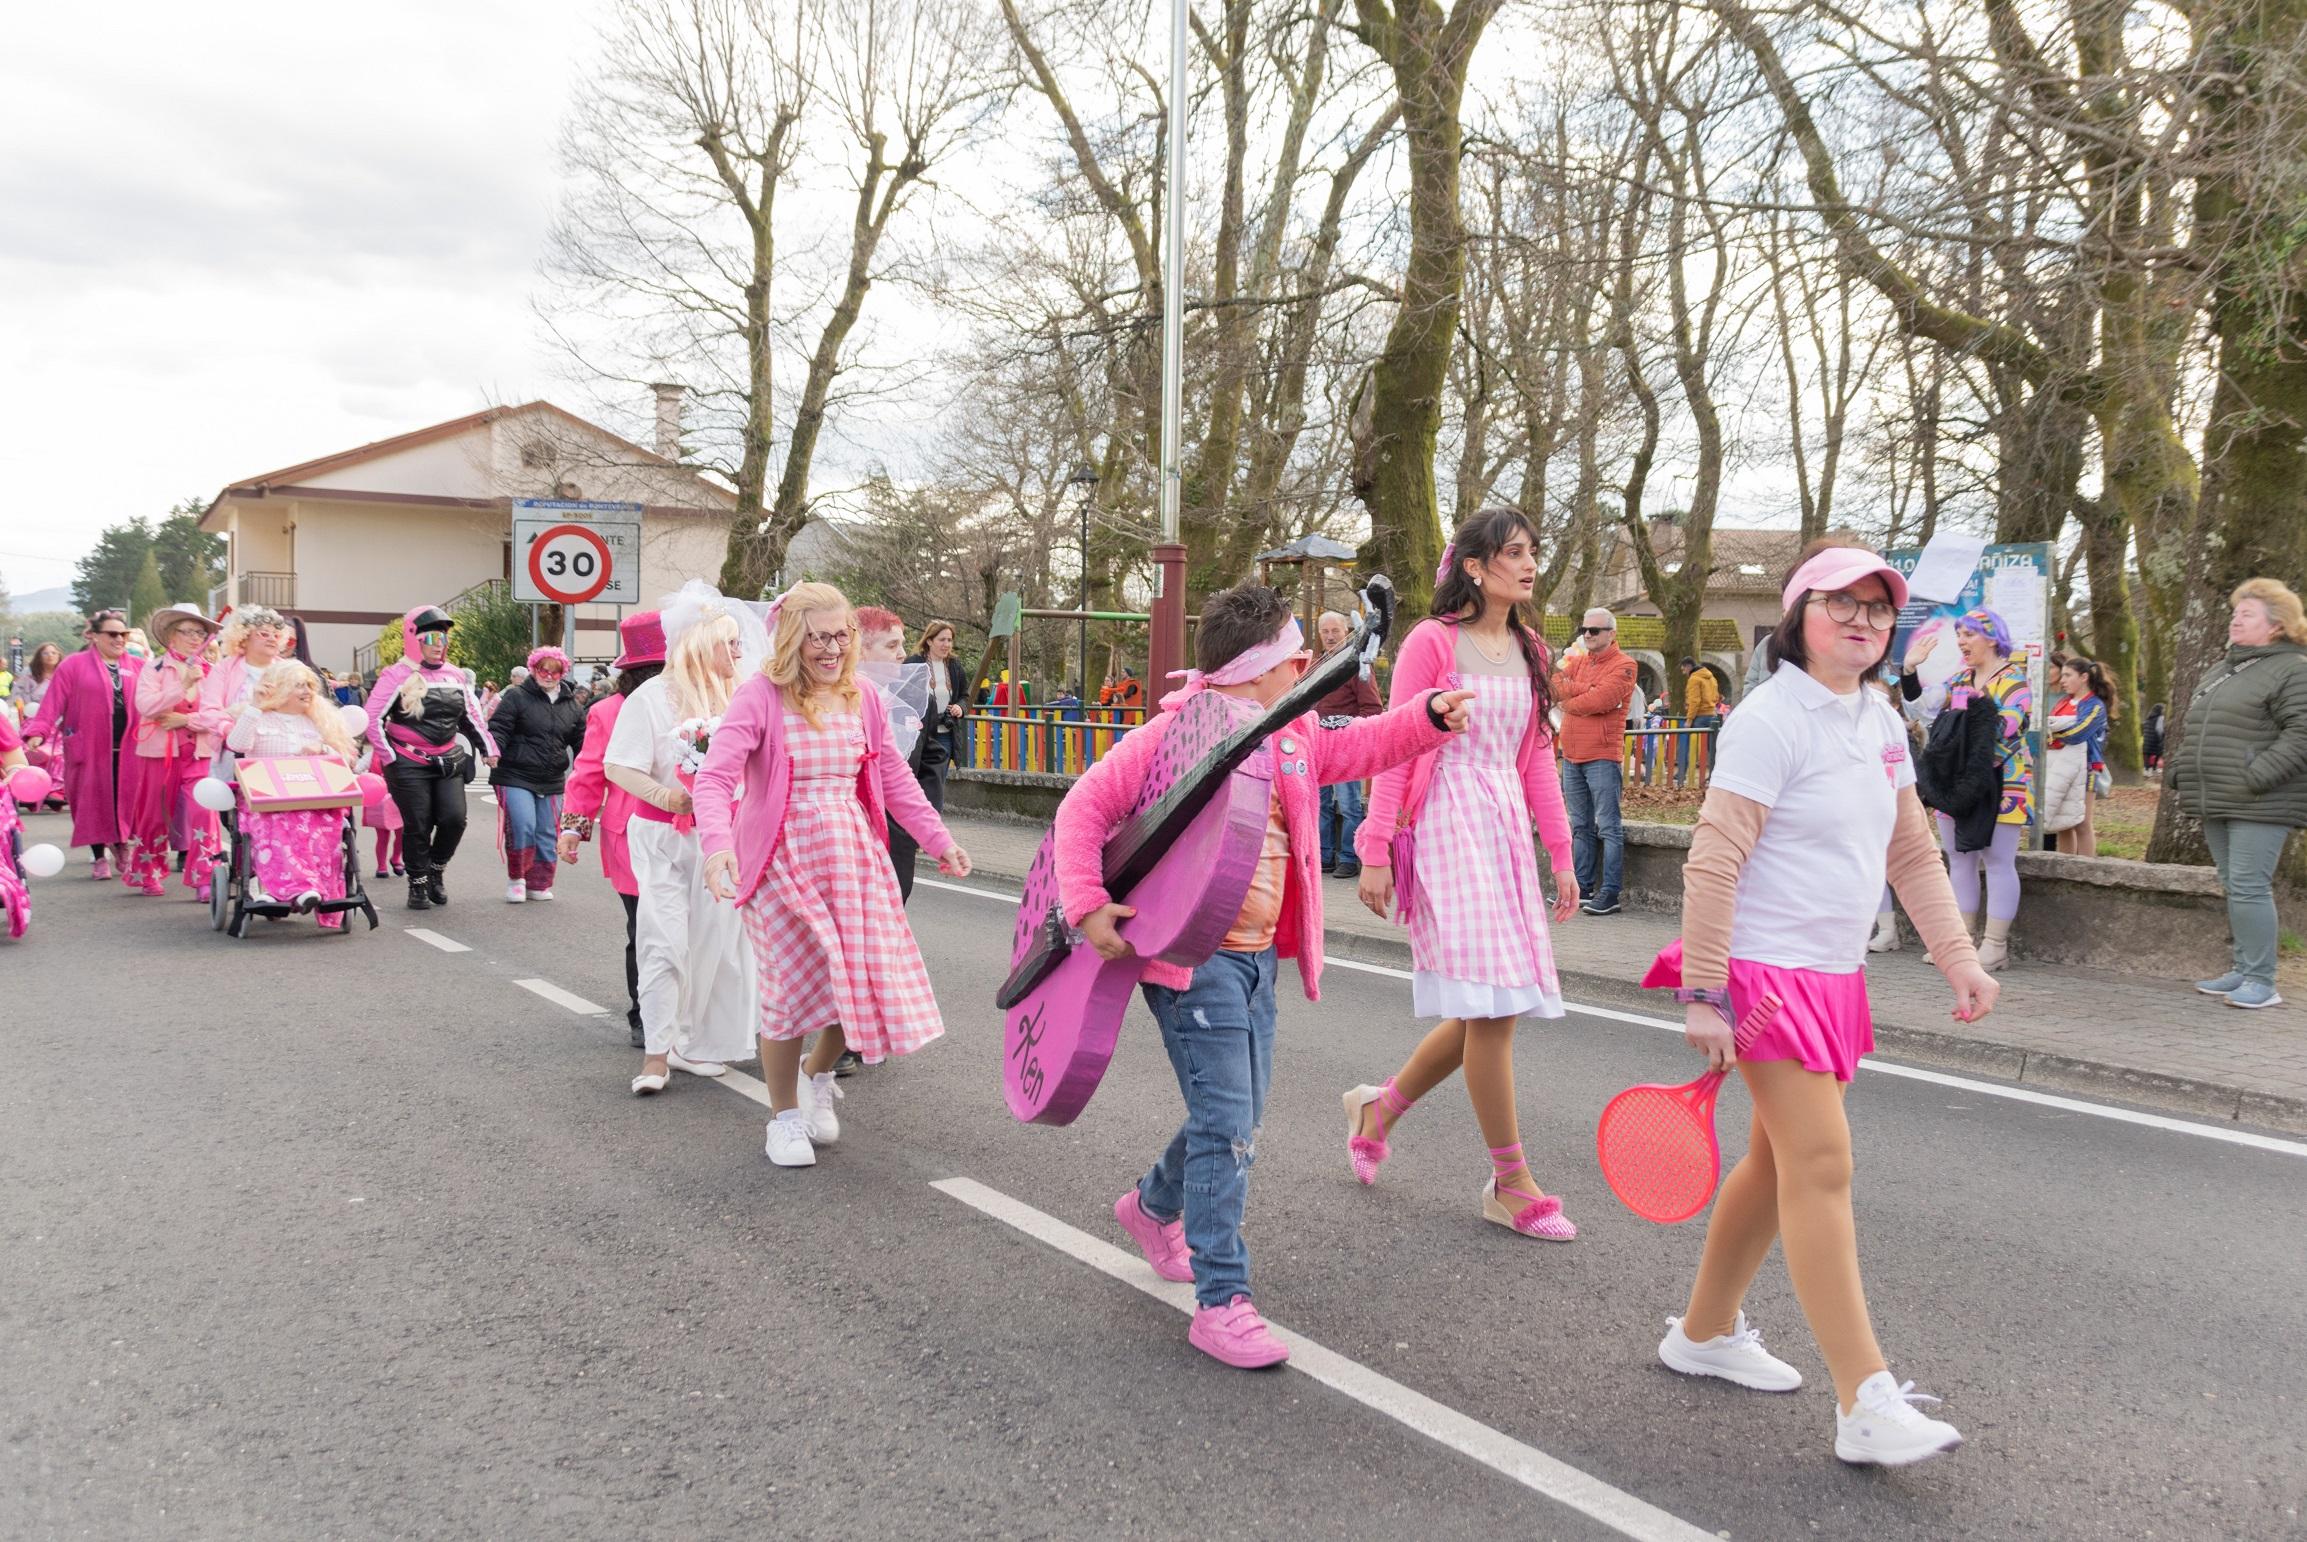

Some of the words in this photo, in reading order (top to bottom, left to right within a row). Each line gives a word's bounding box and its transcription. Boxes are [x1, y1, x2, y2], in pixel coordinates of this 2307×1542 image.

[600, 535, 625, 545] NTE
[547, 551, 594, 577] 30
[605, 580, 622, 591] SE
